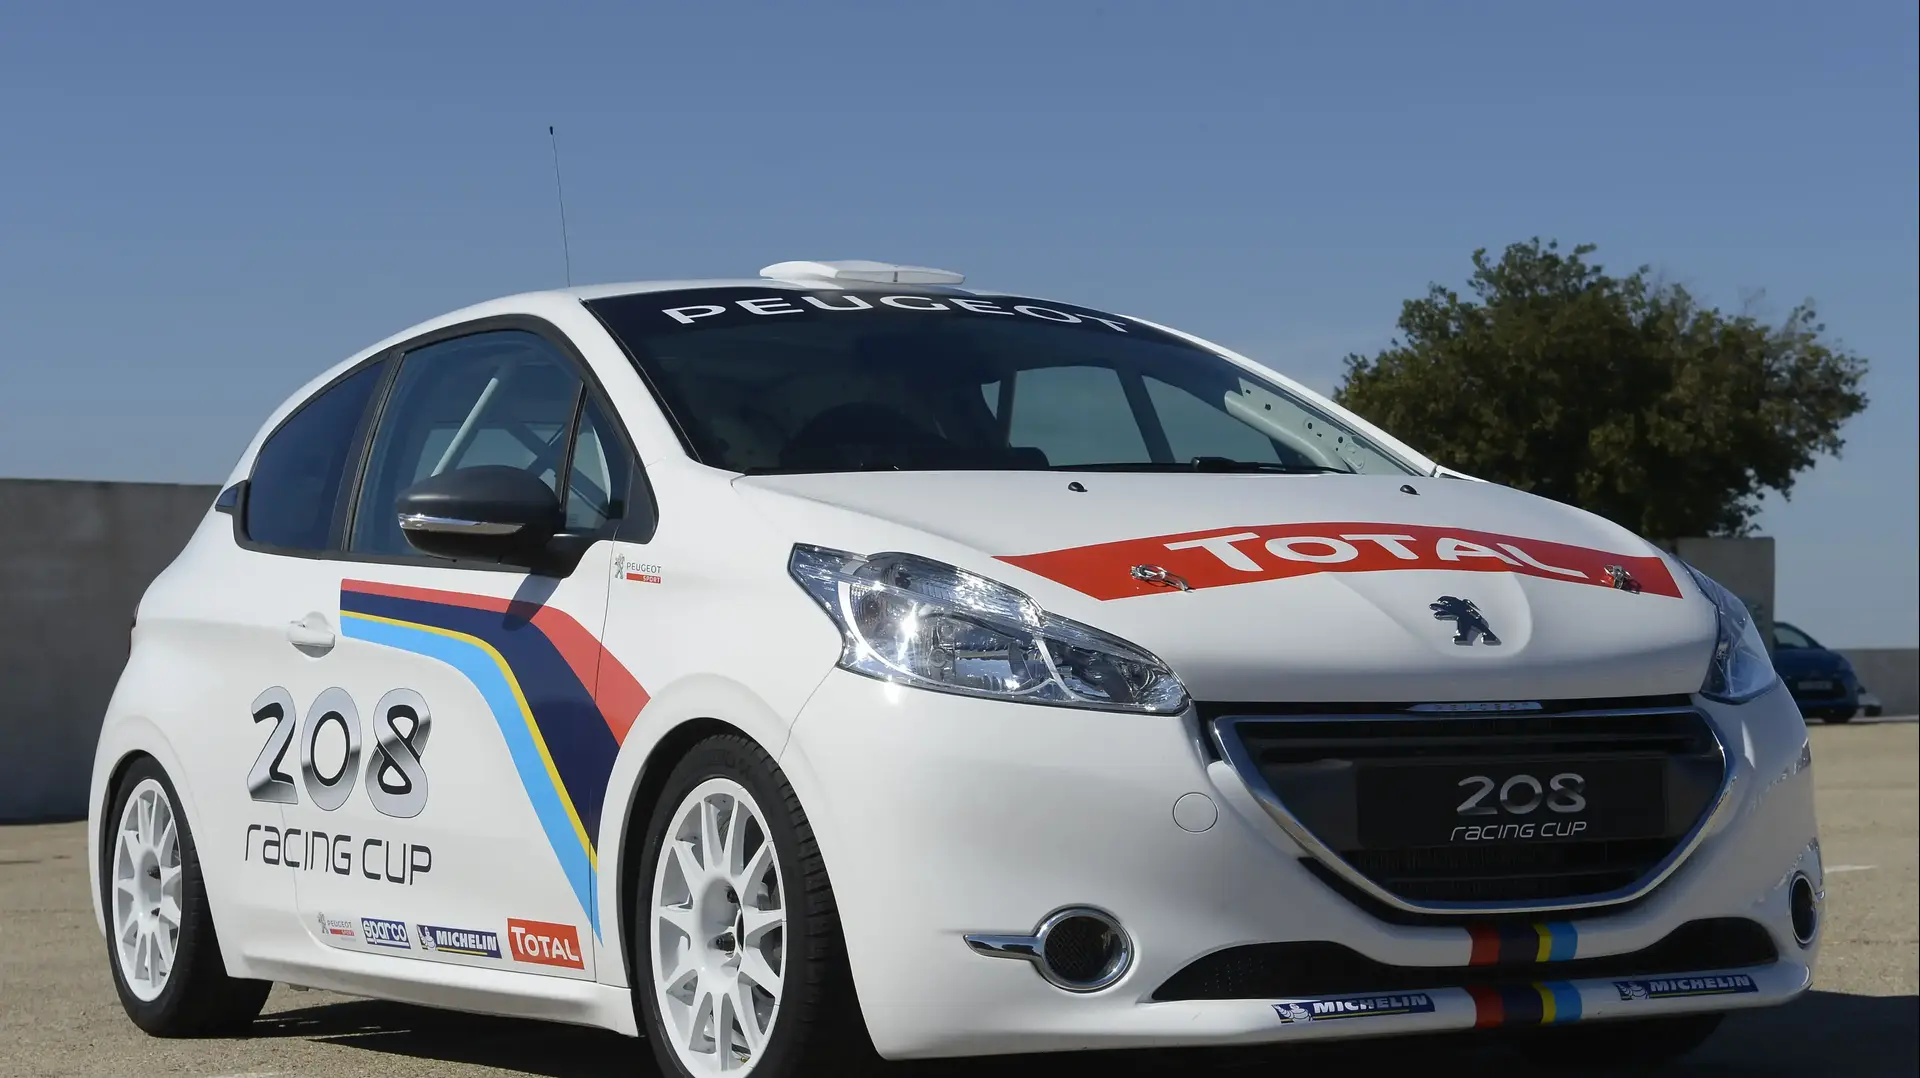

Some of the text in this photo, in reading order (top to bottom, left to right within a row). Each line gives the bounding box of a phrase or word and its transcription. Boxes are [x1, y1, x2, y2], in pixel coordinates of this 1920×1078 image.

[662, 294, 1129, 333] PEUGEOT
[626, 562, 661, 573] PEUGEOT
[1164, 532, 1590, 580] TOTAL
[247, 686, 432, 818] 208
[1456, 773, 1586, 815] 208
[1540, 821, 1588, 838] CUP
[362, 838, 432, 886] CUP
[363, 919, 407, 945] sparco
[435, 930, 498, 951] MICHELIN
[510, 926, 581, 963] TOTAL
[1650, 975, 1751, 992] MICHELIN
[1312, 994, 1428, 1014] MICHELIN
